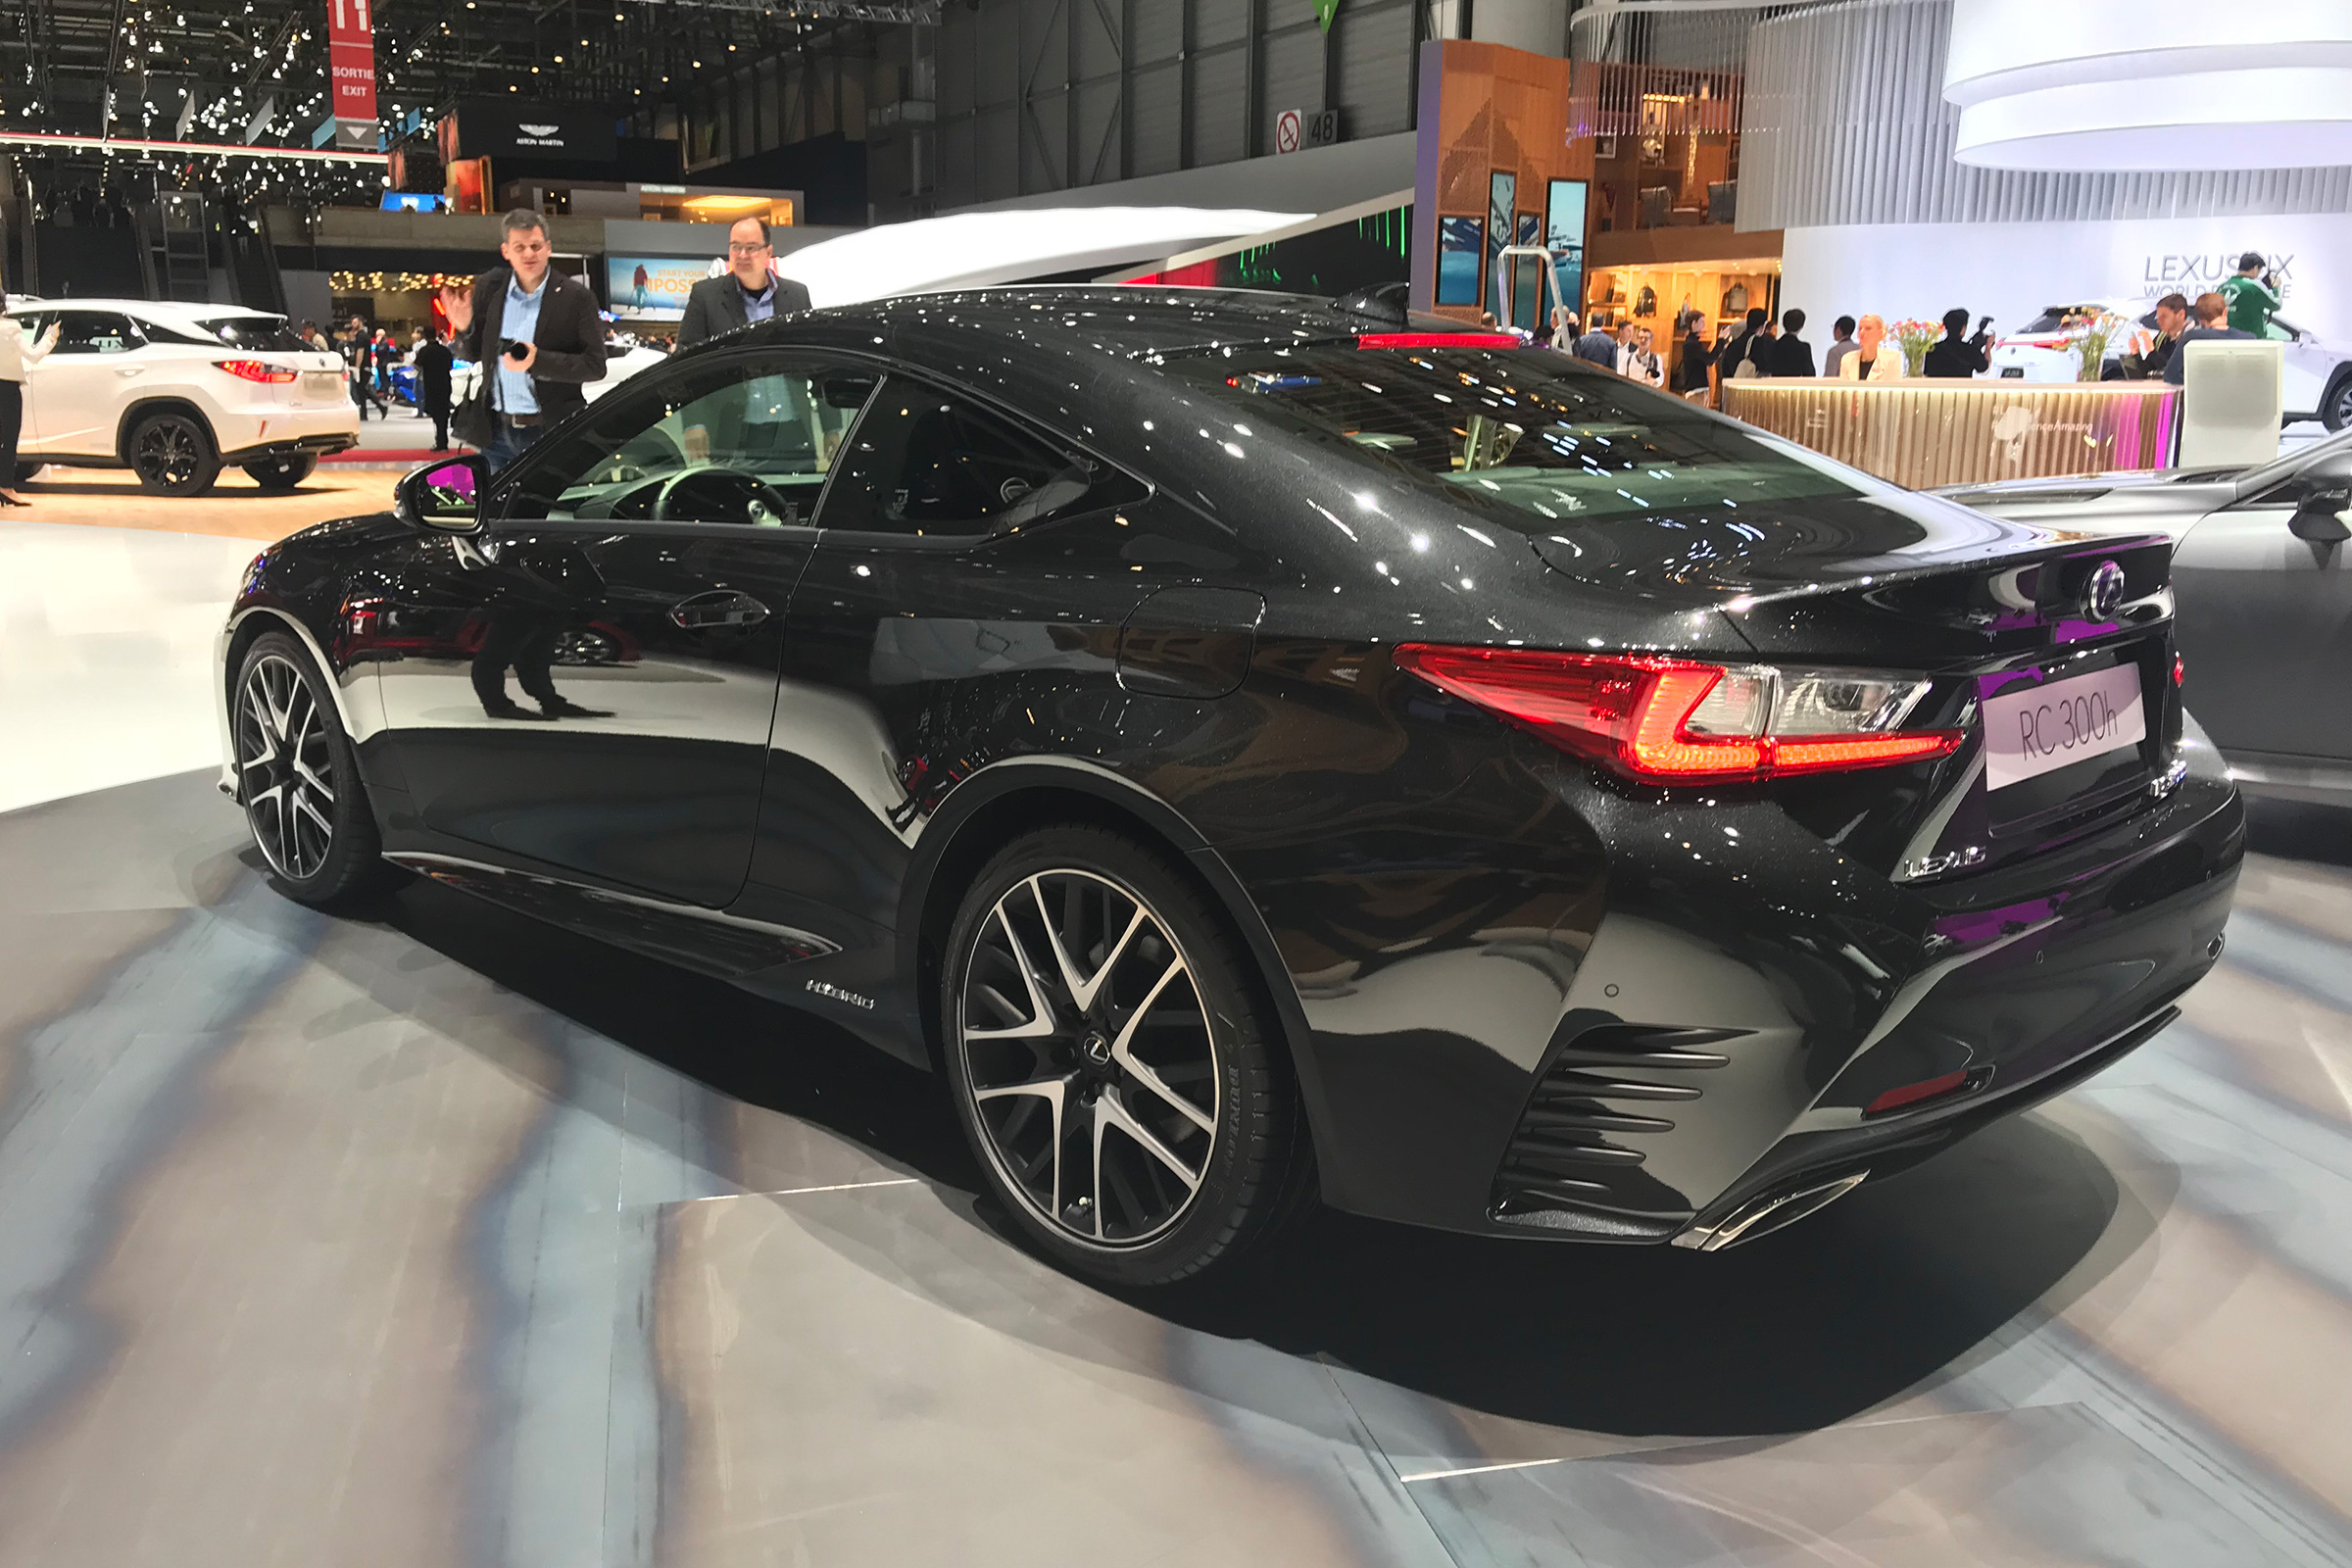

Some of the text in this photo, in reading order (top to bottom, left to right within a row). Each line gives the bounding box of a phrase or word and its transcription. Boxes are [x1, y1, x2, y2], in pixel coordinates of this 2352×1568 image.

[332, 67, 374, 79] SORTIE
[341, 85, 367, 97] EXIT
[1311, 113, 1333, 142] 48
[2144, 254, 2240, 281] LEXUS
[2019, 690, 2118, 760] RC 300h
